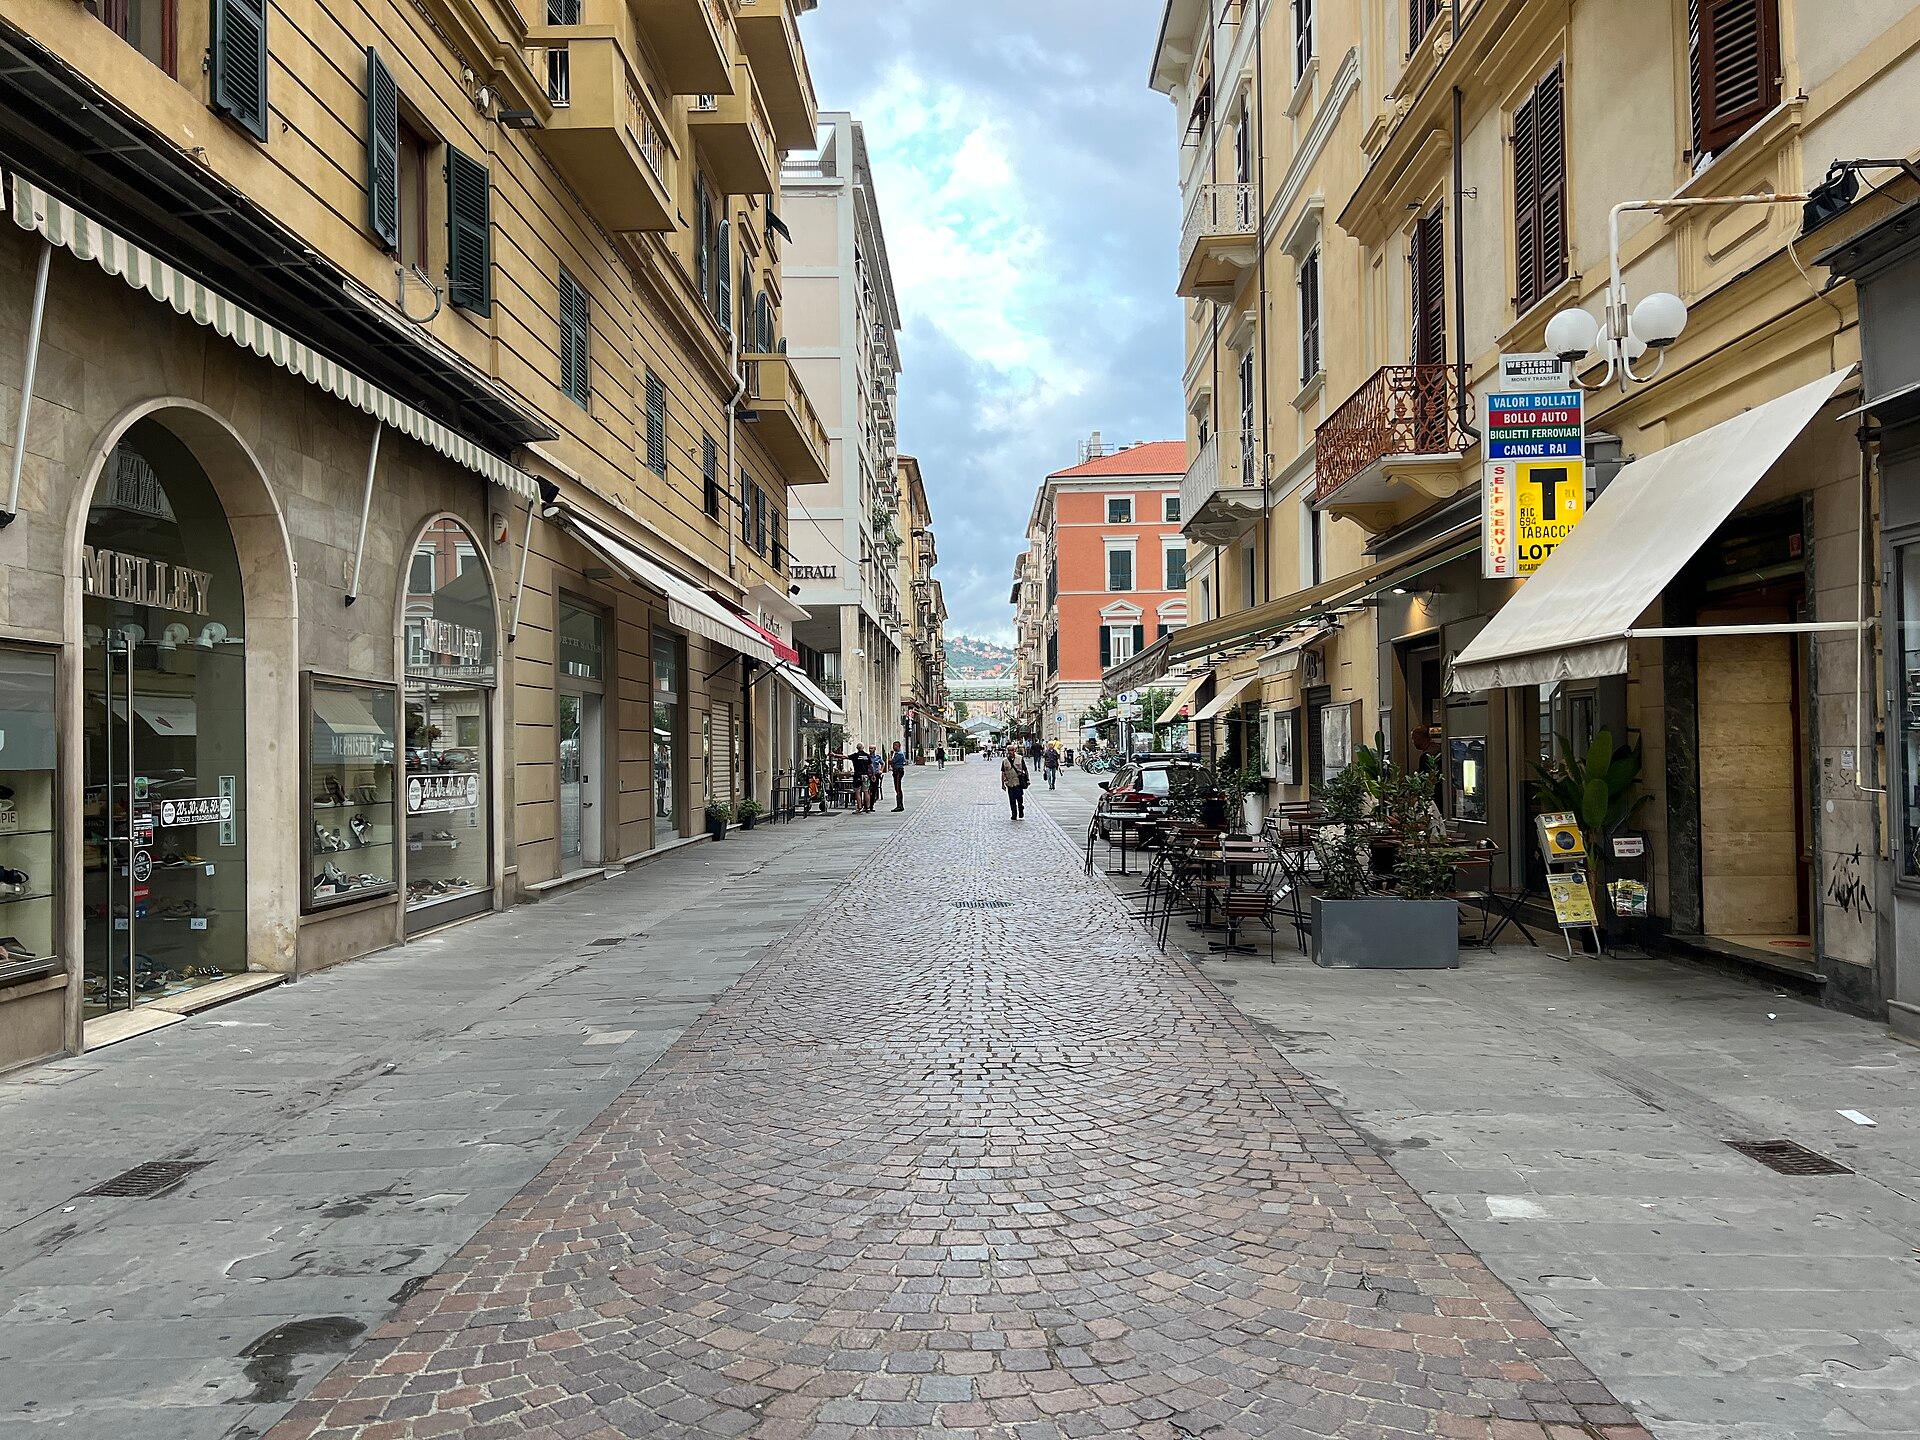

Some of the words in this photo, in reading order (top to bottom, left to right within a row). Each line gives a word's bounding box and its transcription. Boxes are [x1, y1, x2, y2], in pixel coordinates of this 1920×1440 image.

[1506, 360, 1553, 369] WESTERN
[1520, 367, 1553, 375] UNION
[1494, 396, 1529, 408] VALORI
[1534, 395, 1576, 407] BOLLATI
[1503, 412, 1537, 424] BOLLO
[1541, 411, 1568, 423] AUTO
[1490, 429, 1529, 440] BIGLIETTI
[1531, 427, 1580, 438] FERROVIARI
[1503, 444, 1544, 456] CANONE
[1549, 443, 1567, 454] RAI
[1494, 466, 1506, 503] SELF
[1530, 467, 1568, 520] T
[1568, 500, 1573, 509] 2
[1519, 517, 1536, 527] 694
[1494, 509, 1506, 573] SERVICE
[1518, 543, 1560, 560] LOT
[83, 544, 214, 616] MELLEY
[331, 735, 368, 756] MEPHISTO
